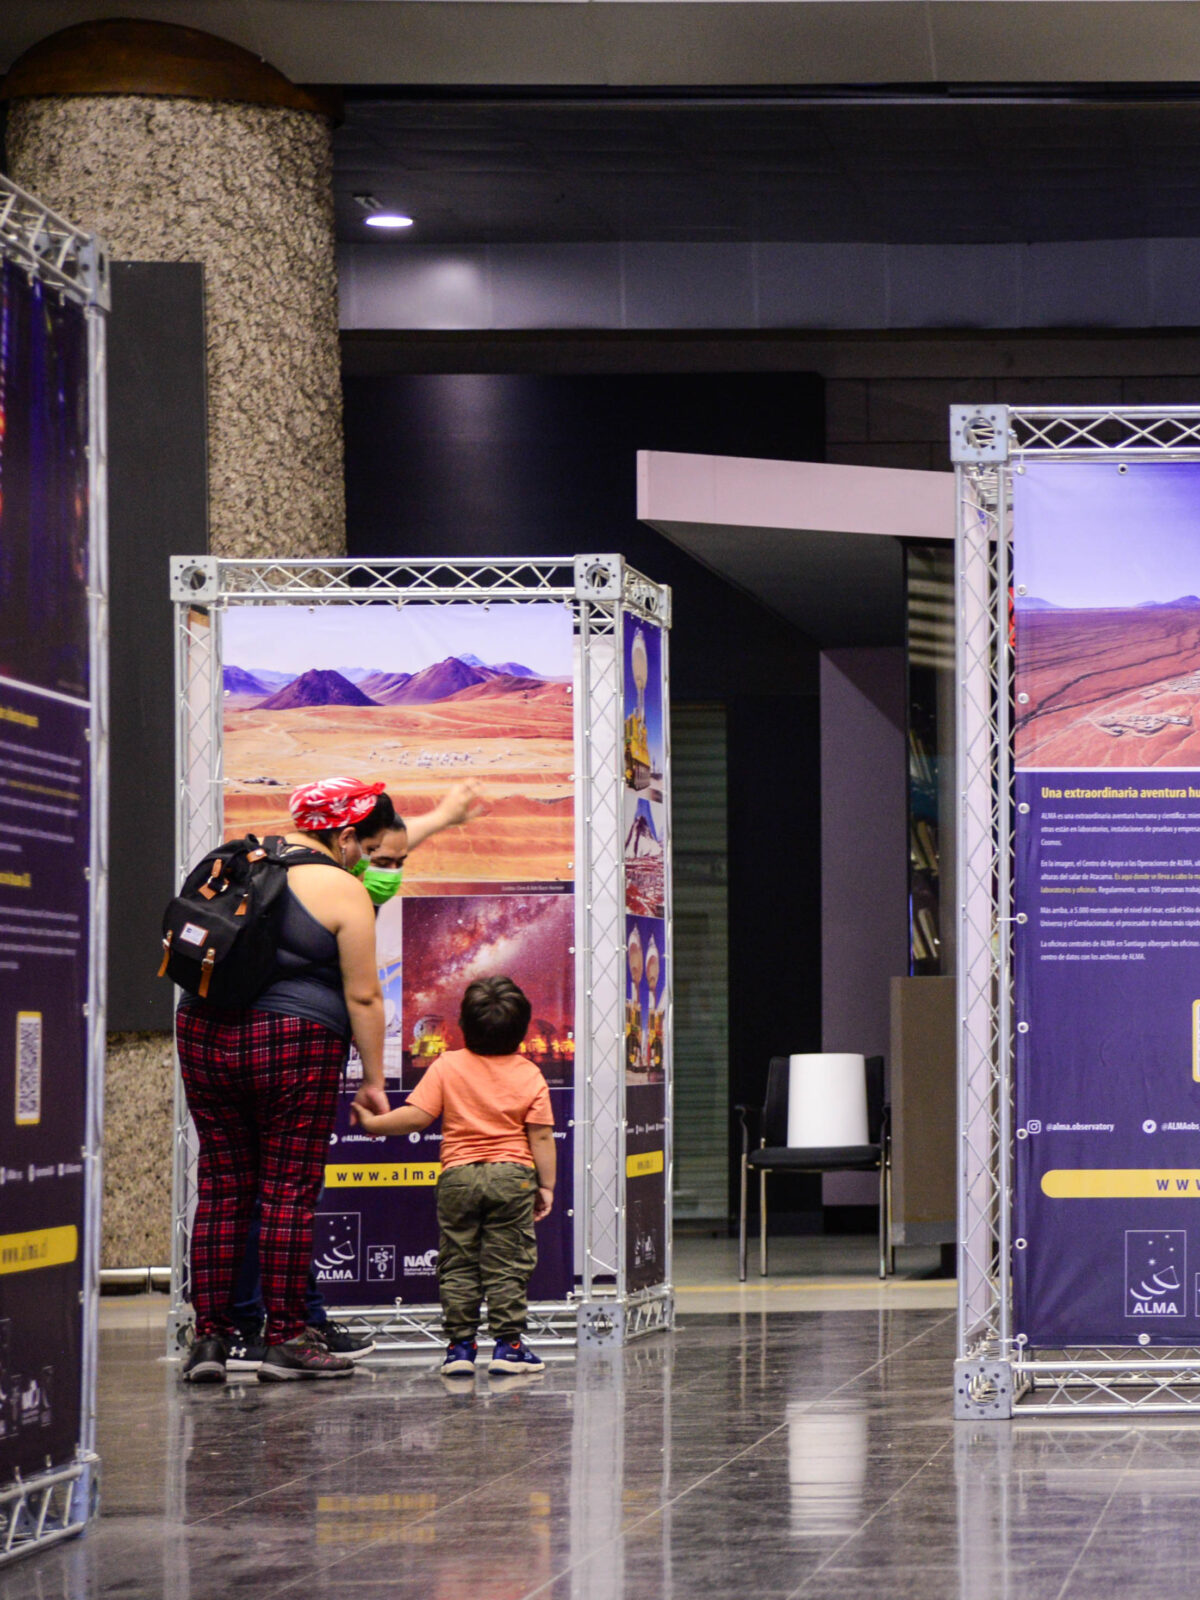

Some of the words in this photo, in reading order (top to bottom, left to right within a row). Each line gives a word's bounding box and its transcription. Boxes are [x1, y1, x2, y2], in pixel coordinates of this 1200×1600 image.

[1041, 786, 1062, 799] Una
[1064, 786, 1138, 799] extraordinaria
[1140, 787, 1187, 799] aventura
[1046, 1122, 1115, 1133] @alma.observatory
[336, 1167, 436, 1182] www.alma
[316, 1268, 353, 1280] ALMA
[1132, 1301, 1178, 1314] ALMA
